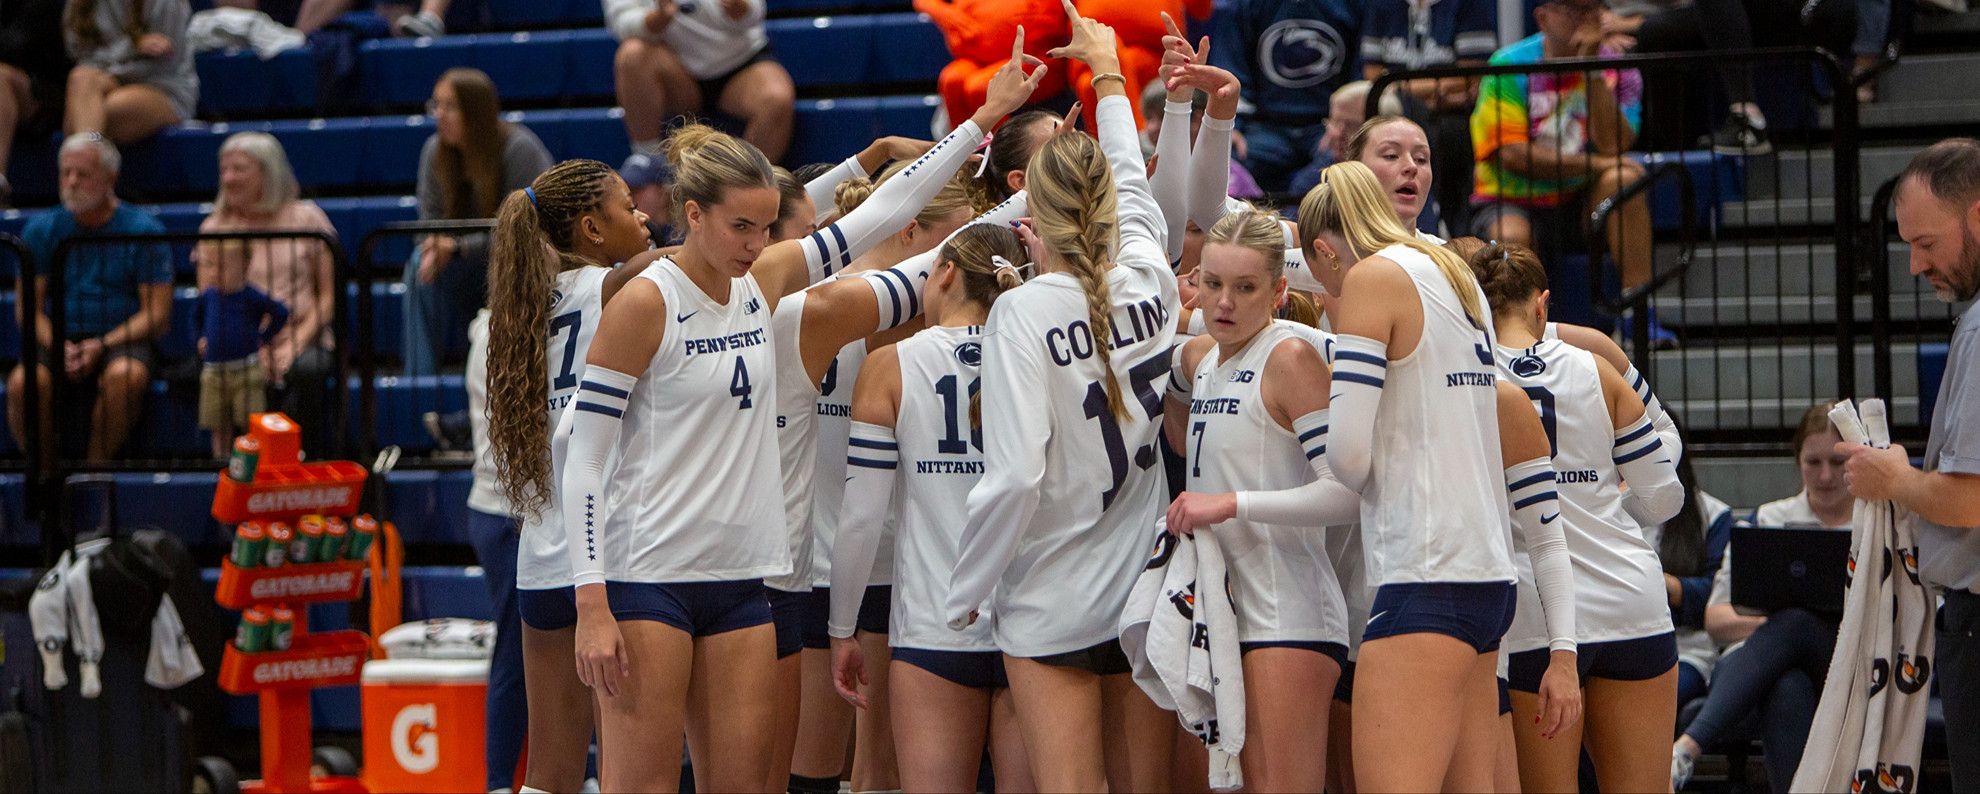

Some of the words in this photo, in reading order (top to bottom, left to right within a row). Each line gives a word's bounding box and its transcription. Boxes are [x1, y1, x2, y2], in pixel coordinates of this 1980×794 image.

[549, 310, 582, 391] 7
[685, 337, 727, 356] PENN
[1046, 295, 1169, 367] COLIN
[730, 355, 752, 410] 4
[1202, 398, 1240, 415] STATE
[1082, 344, 1174, 513] 15
[1192, 422, 1206, 477] 7
[247, 487, 351, 513] GATORADE
[251, 571, 354, 599] GATORADE
[253, 655, 357, 684] GATORADE
[391, 703, 439, 774] G
